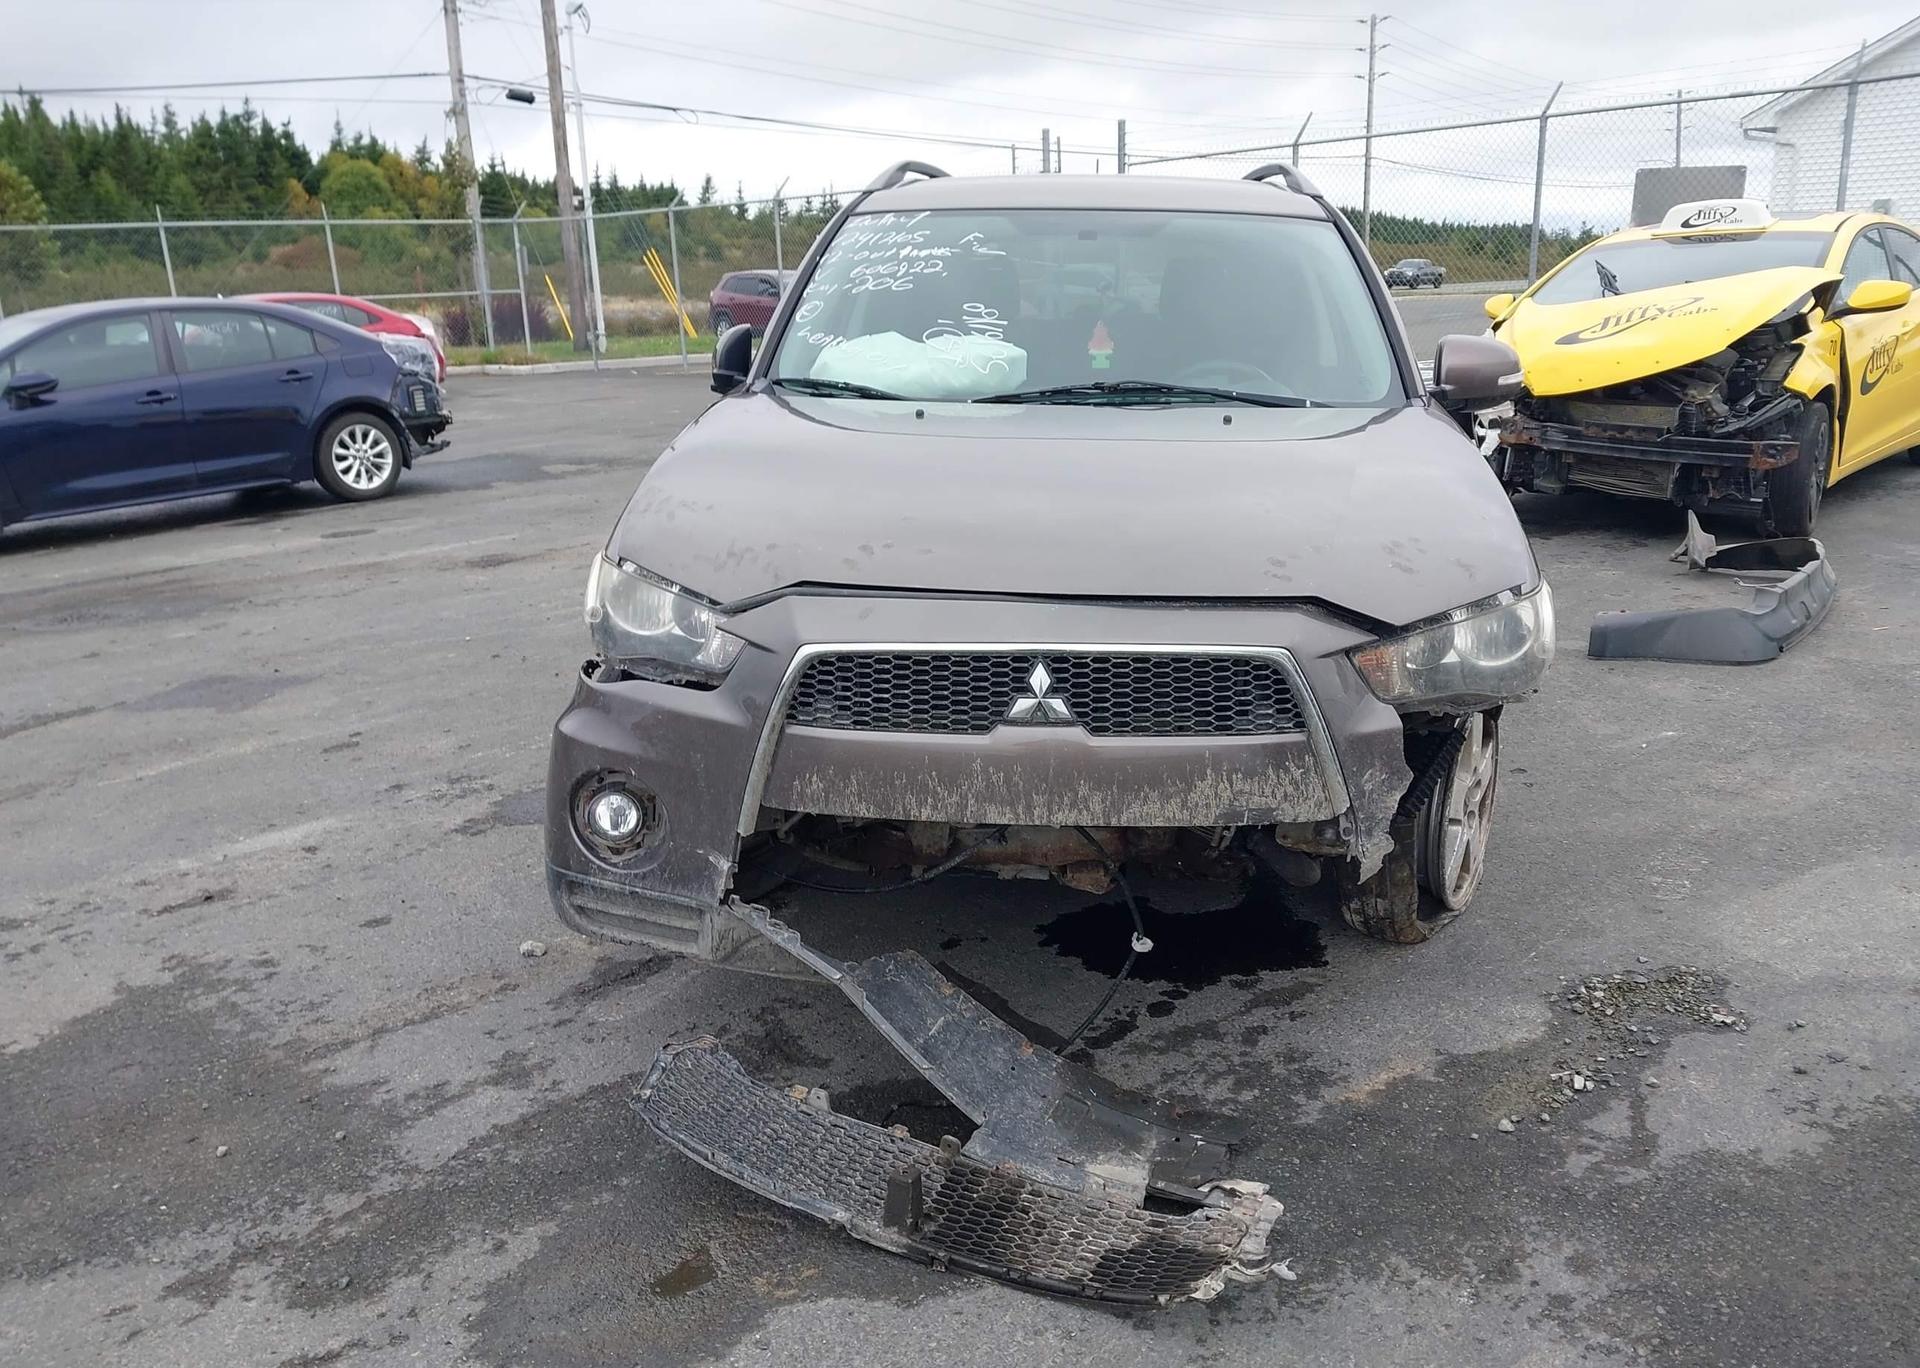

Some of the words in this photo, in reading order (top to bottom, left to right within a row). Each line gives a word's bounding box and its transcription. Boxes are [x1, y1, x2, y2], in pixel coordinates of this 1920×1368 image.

[1694, 204, 1728, 223] Jiffy
[1590, 303, 1674, 334] Jiffy
[1869, 340, 1893, 375] Jiffy
